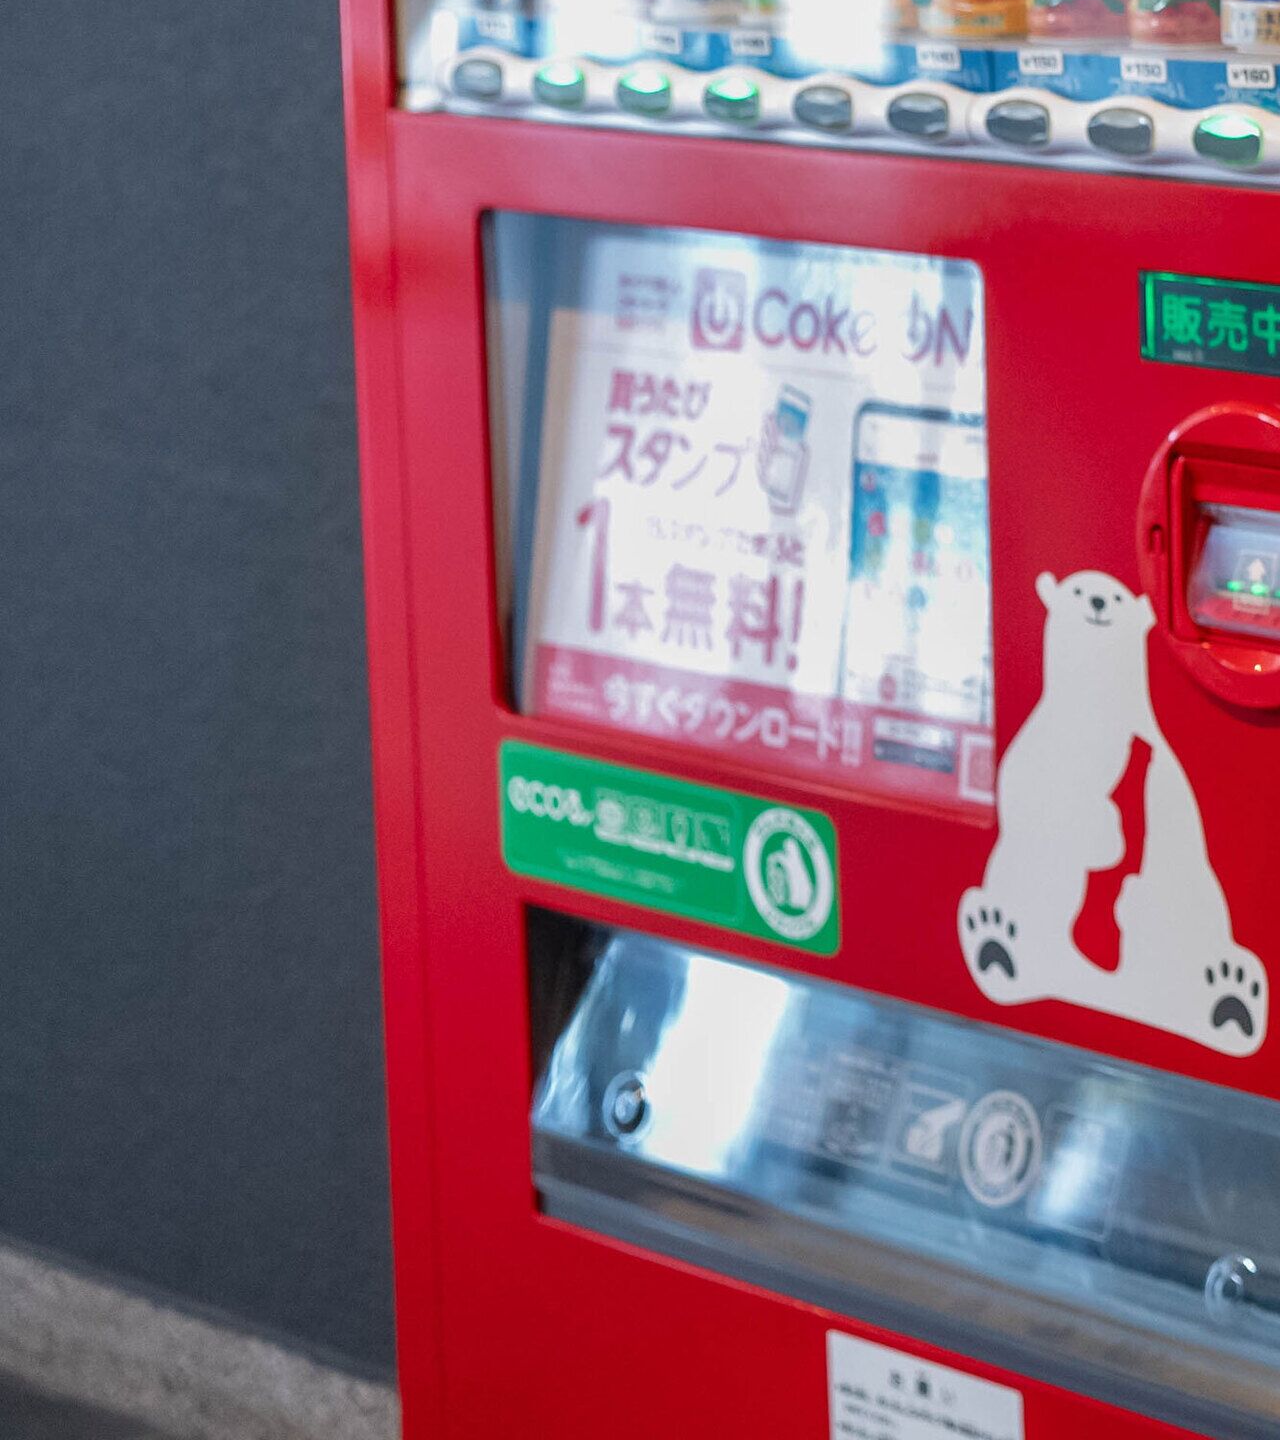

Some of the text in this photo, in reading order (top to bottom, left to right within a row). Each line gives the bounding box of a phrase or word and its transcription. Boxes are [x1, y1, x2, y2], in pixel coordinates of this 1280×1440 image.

[753, 287, 878, 357] Coke
[601, 423, 755, 498] スタンプ
